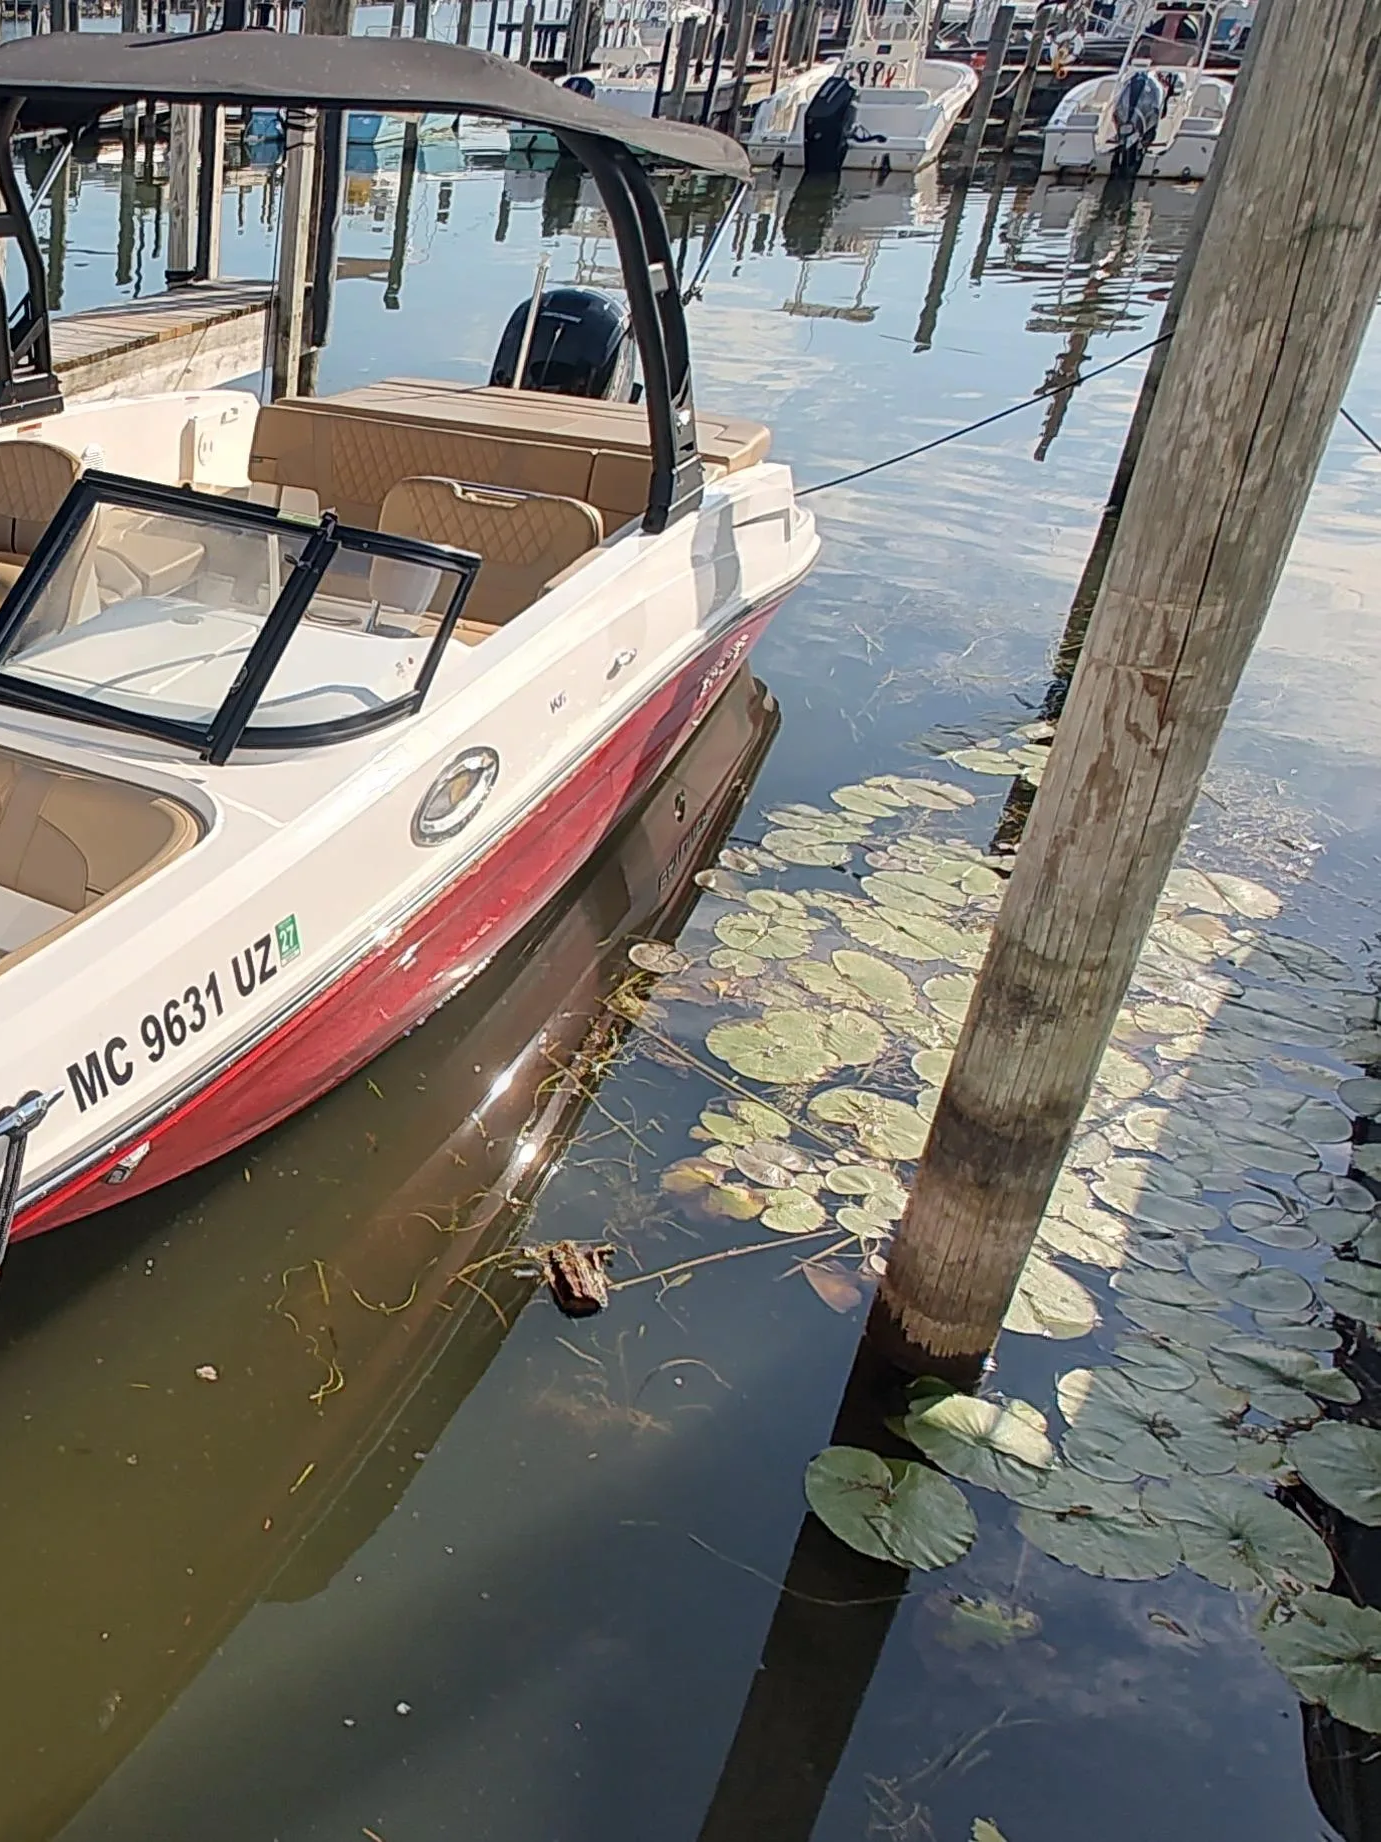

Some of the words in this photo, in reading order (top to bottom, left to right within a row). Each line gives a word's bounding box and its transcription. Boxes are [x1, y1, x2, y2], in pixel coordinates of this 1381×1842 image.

[279, 924, 295, 953] 27
[66, 1037, 133, 1113] MC
[141, 971, 224, 1063] 9631
[231, 934, 278, 997] UZ
